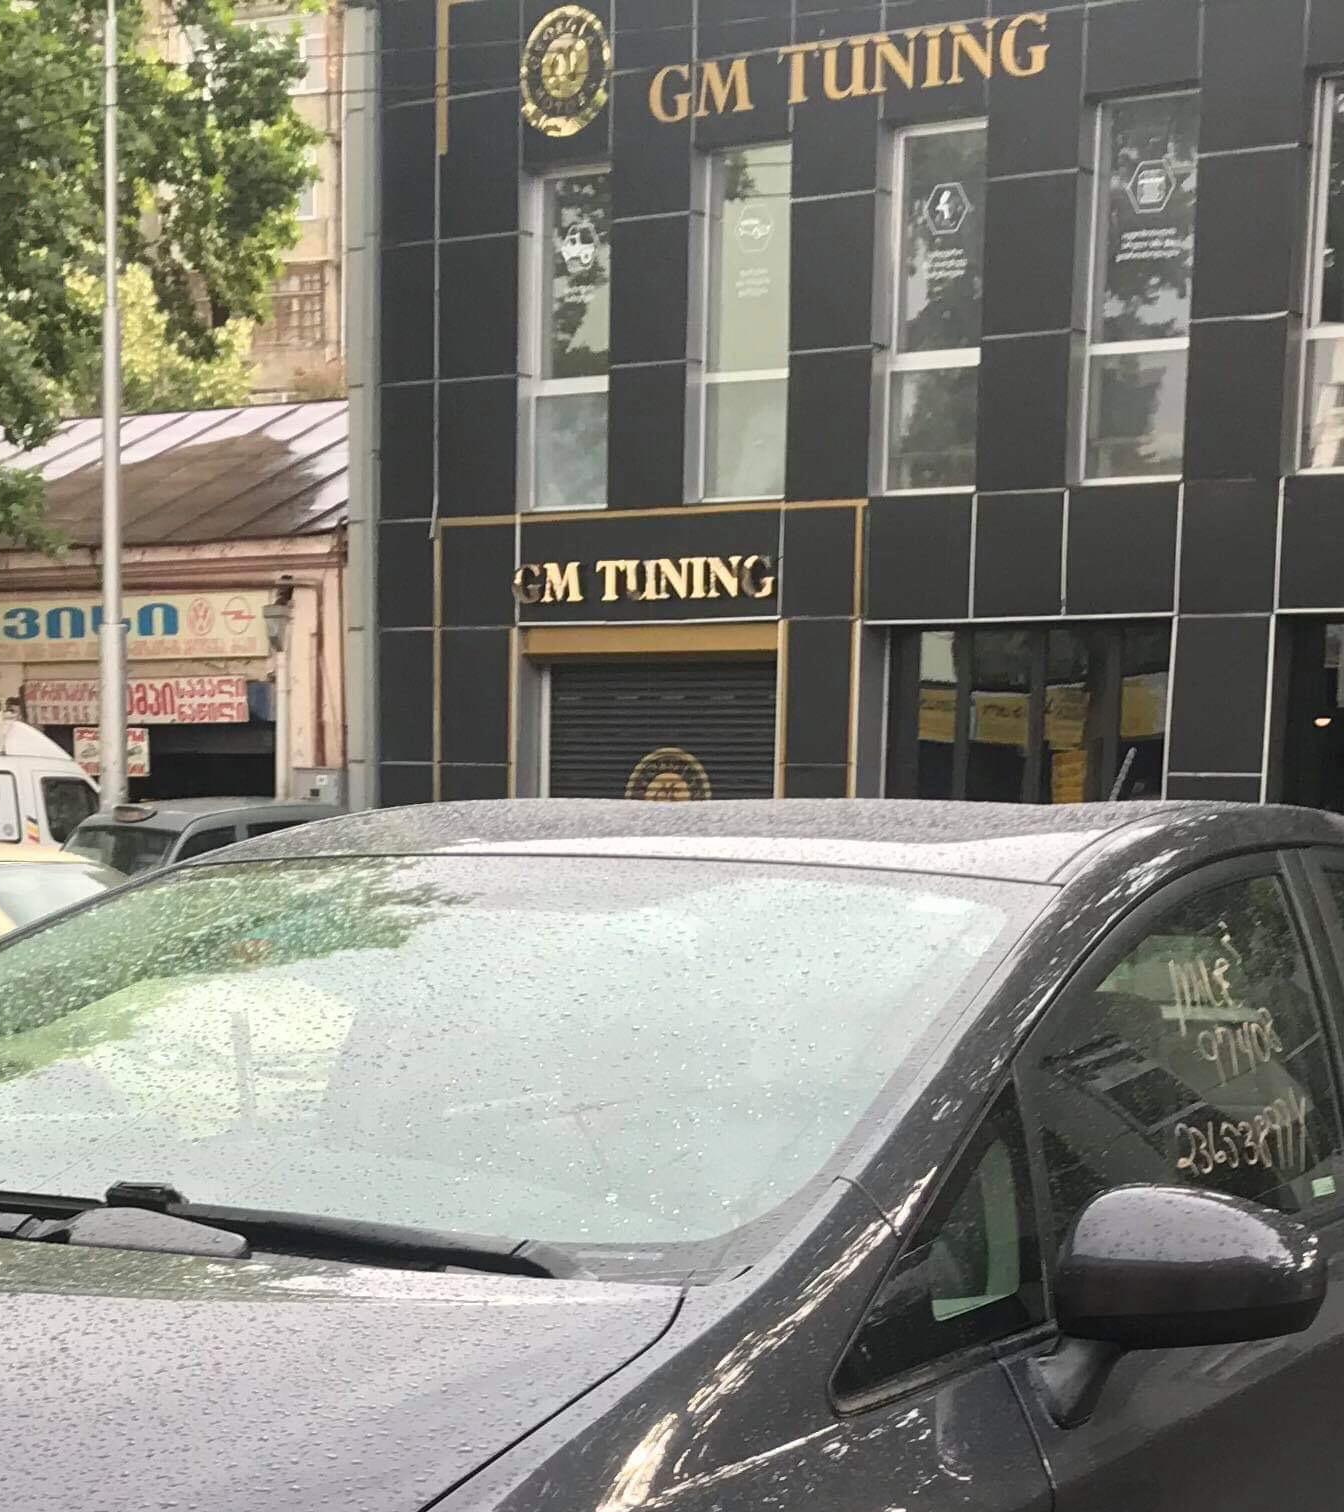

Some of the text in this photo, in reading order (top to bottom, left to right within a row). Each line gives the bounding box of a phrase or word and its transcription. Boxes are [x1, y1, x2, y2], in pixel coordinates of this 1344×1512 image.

[649, 12, 1051, 124] GM TUNING
[512, 555, 775, 604] GM TUNING
